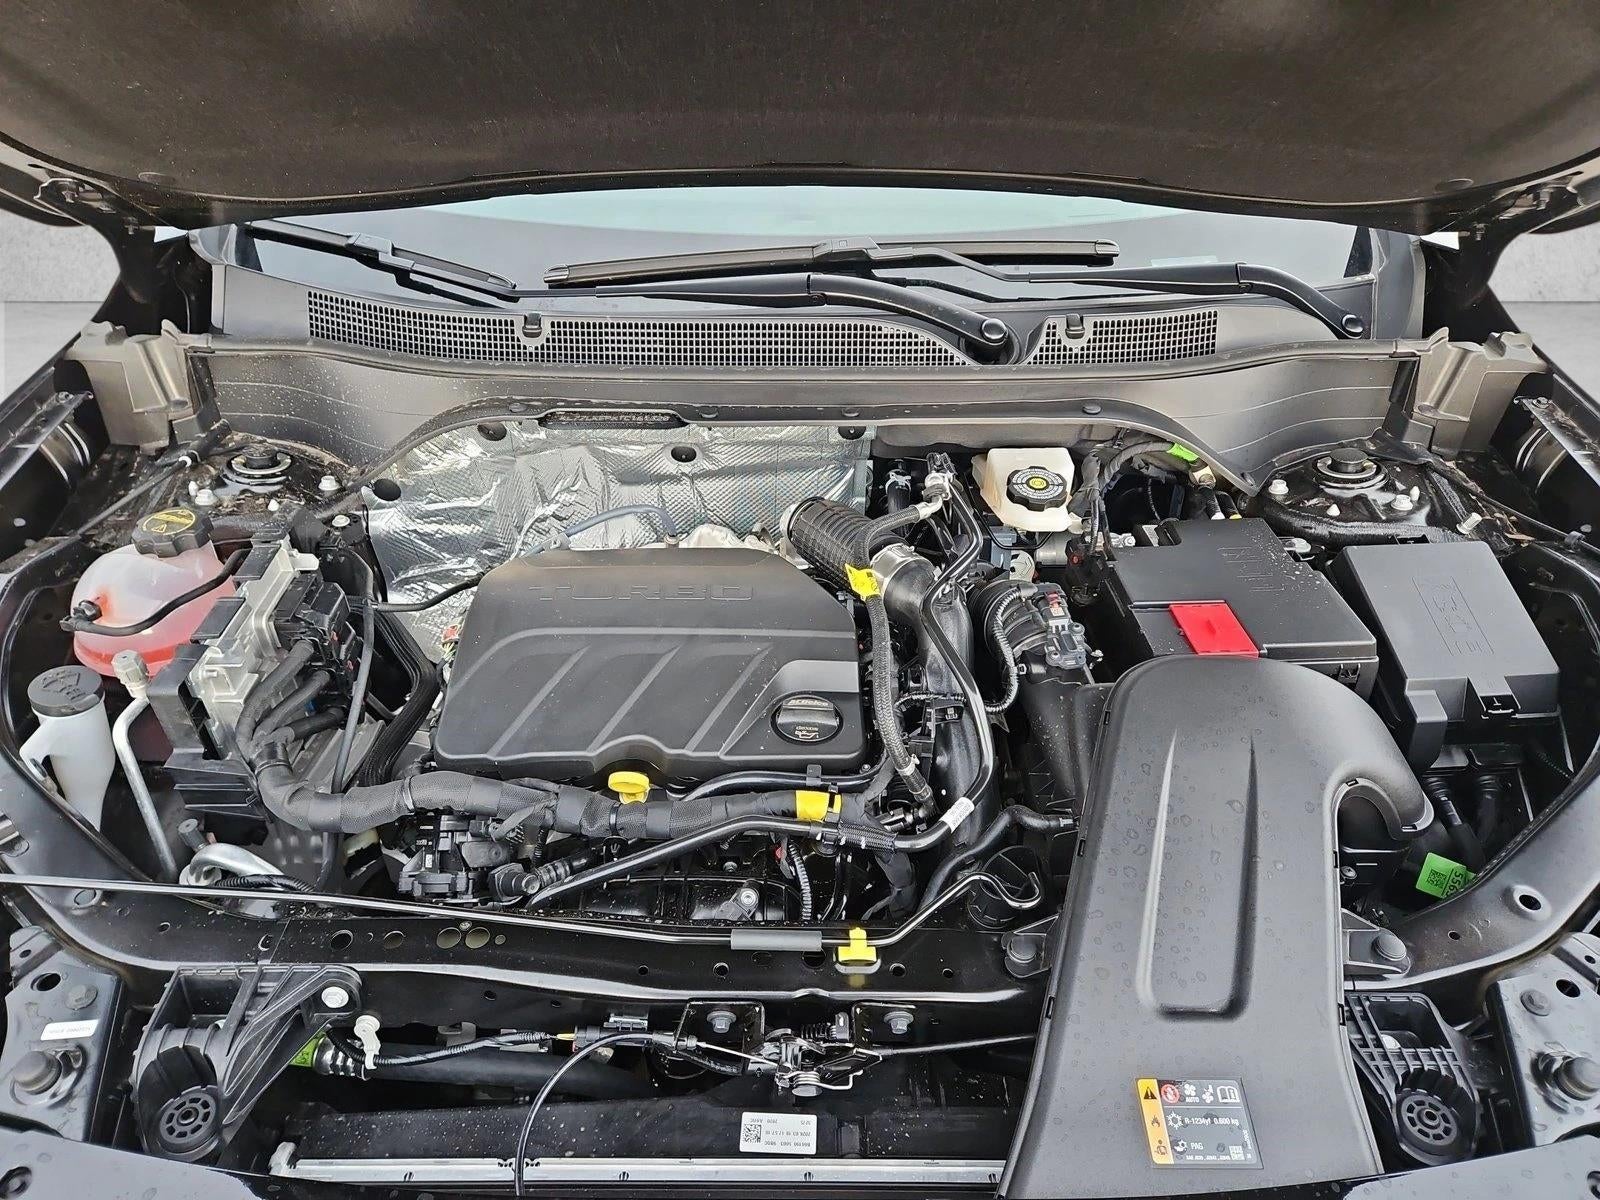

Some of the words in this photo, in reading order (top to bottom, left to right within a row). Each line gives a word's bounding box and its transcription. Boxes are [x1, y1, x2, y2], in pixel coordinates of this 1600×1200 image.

[528, 584, 753, 600] TURBO
[1184, 1117, 1211, 1126] R-1234yf
[1231, 1117, 1240, 1126] kg
[1190, 1142, 1204, 1150] PAG
